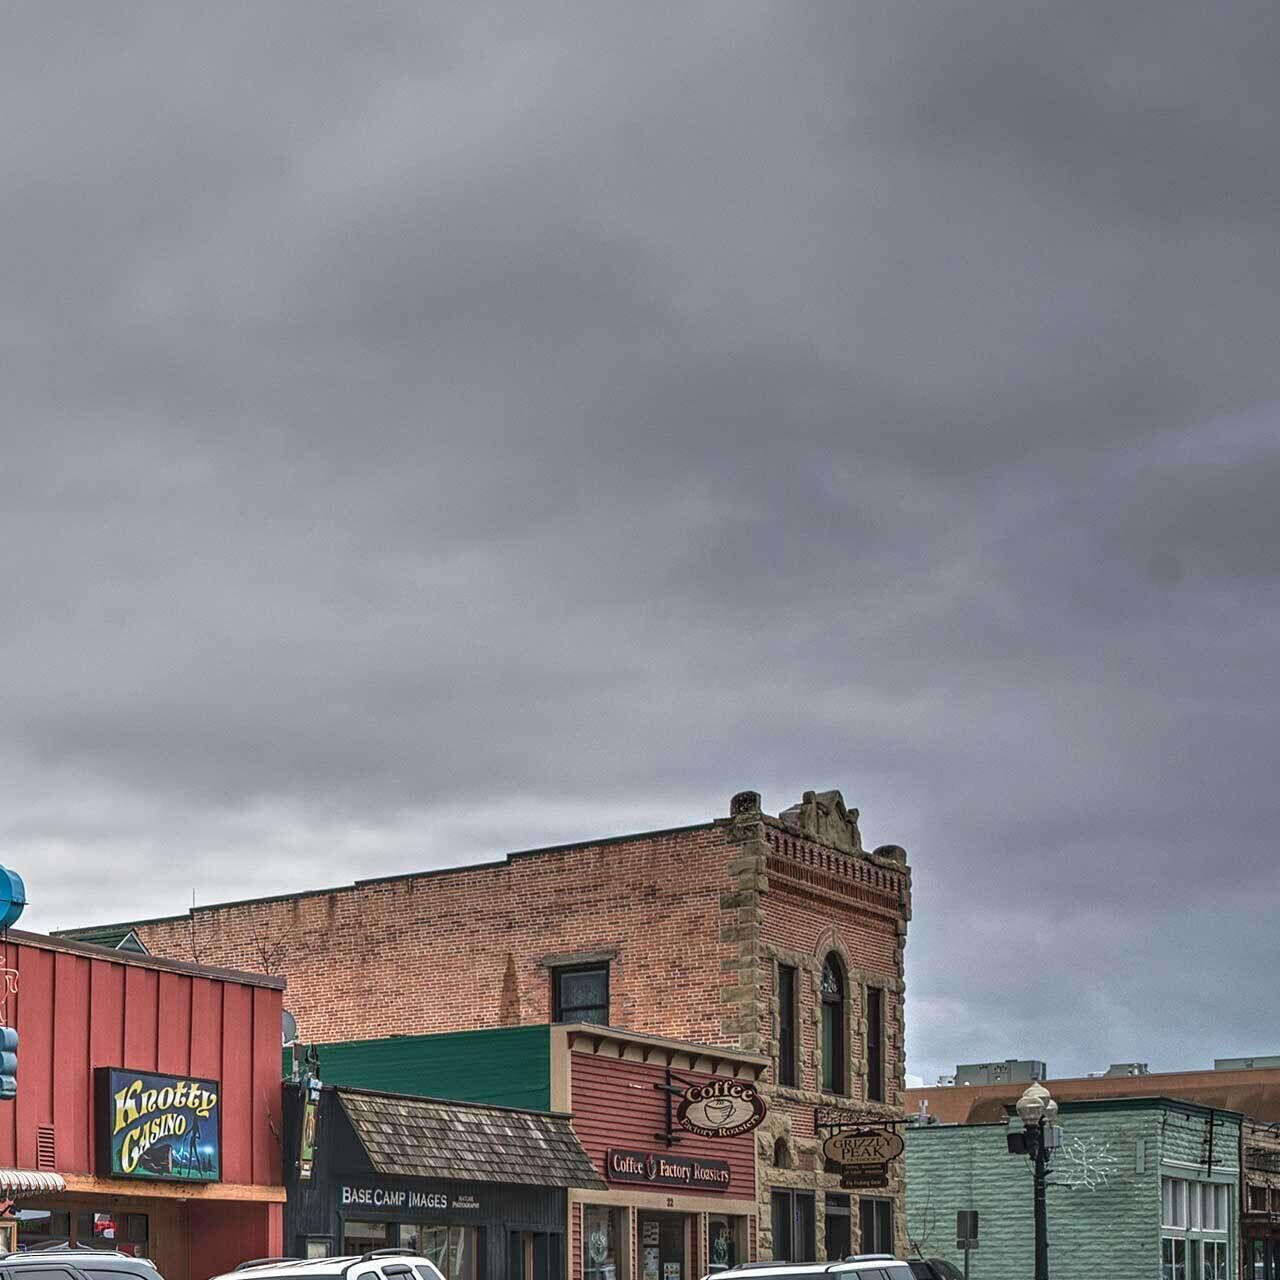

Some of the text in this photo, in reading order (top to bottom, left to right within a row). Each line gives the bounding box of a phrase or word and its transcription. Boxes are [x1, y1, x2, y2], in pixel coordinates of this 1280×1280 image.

[687, 1080, 753, 1101] Coffee
[113, 1080, 217, 1135] Knotty
[680, 1115, 760, 1138] Factory Roasters
[122, 1113, 186, 1173] CASINO
[833, 1137, 893, 1149] GRIZZLY
[842, 1147, 885, 1160] PEAK
[614, 1155, 729, 1183] Coffee Factory Roasters
[342, 1186, 448, 1208] BASE CAMP IMAGES
[666, 1198, 674, 1207] 22
